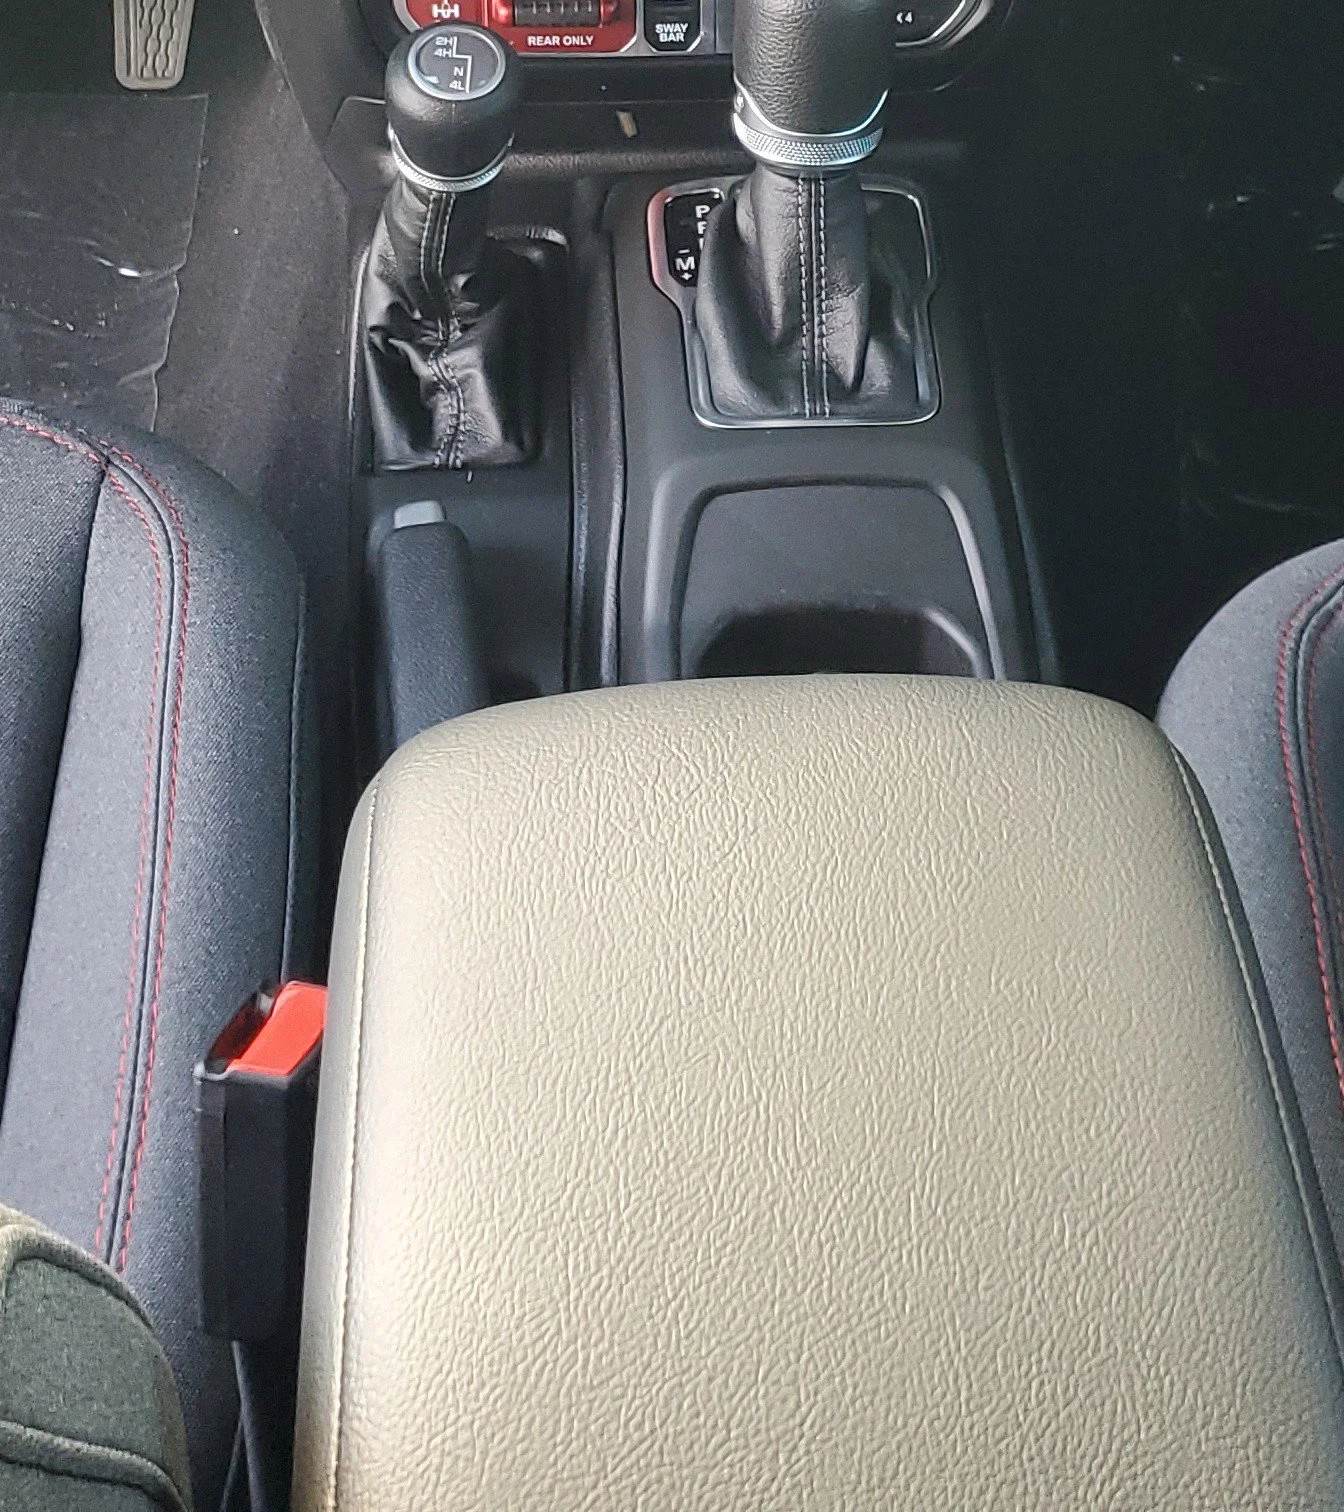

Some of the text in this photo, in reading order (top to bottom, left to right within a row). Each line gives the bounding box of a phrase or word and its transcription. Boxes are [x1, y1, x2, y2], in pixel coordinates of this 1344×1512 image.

[903, 12, 913, 23] 4
[655, 23, 689, 34] SWAY
[435, 36, 453, 46] 2H
[528, 35, 594, 46] REAR ONLY
[659, 33, 685, 43] BAR
[434, 47, 453, 58] 4H
[453, 66, 464, 76] N
[449, 80, 464, 91] 4L
[695, 205, 711, 219] P
[675, 256, 696, 271] M
